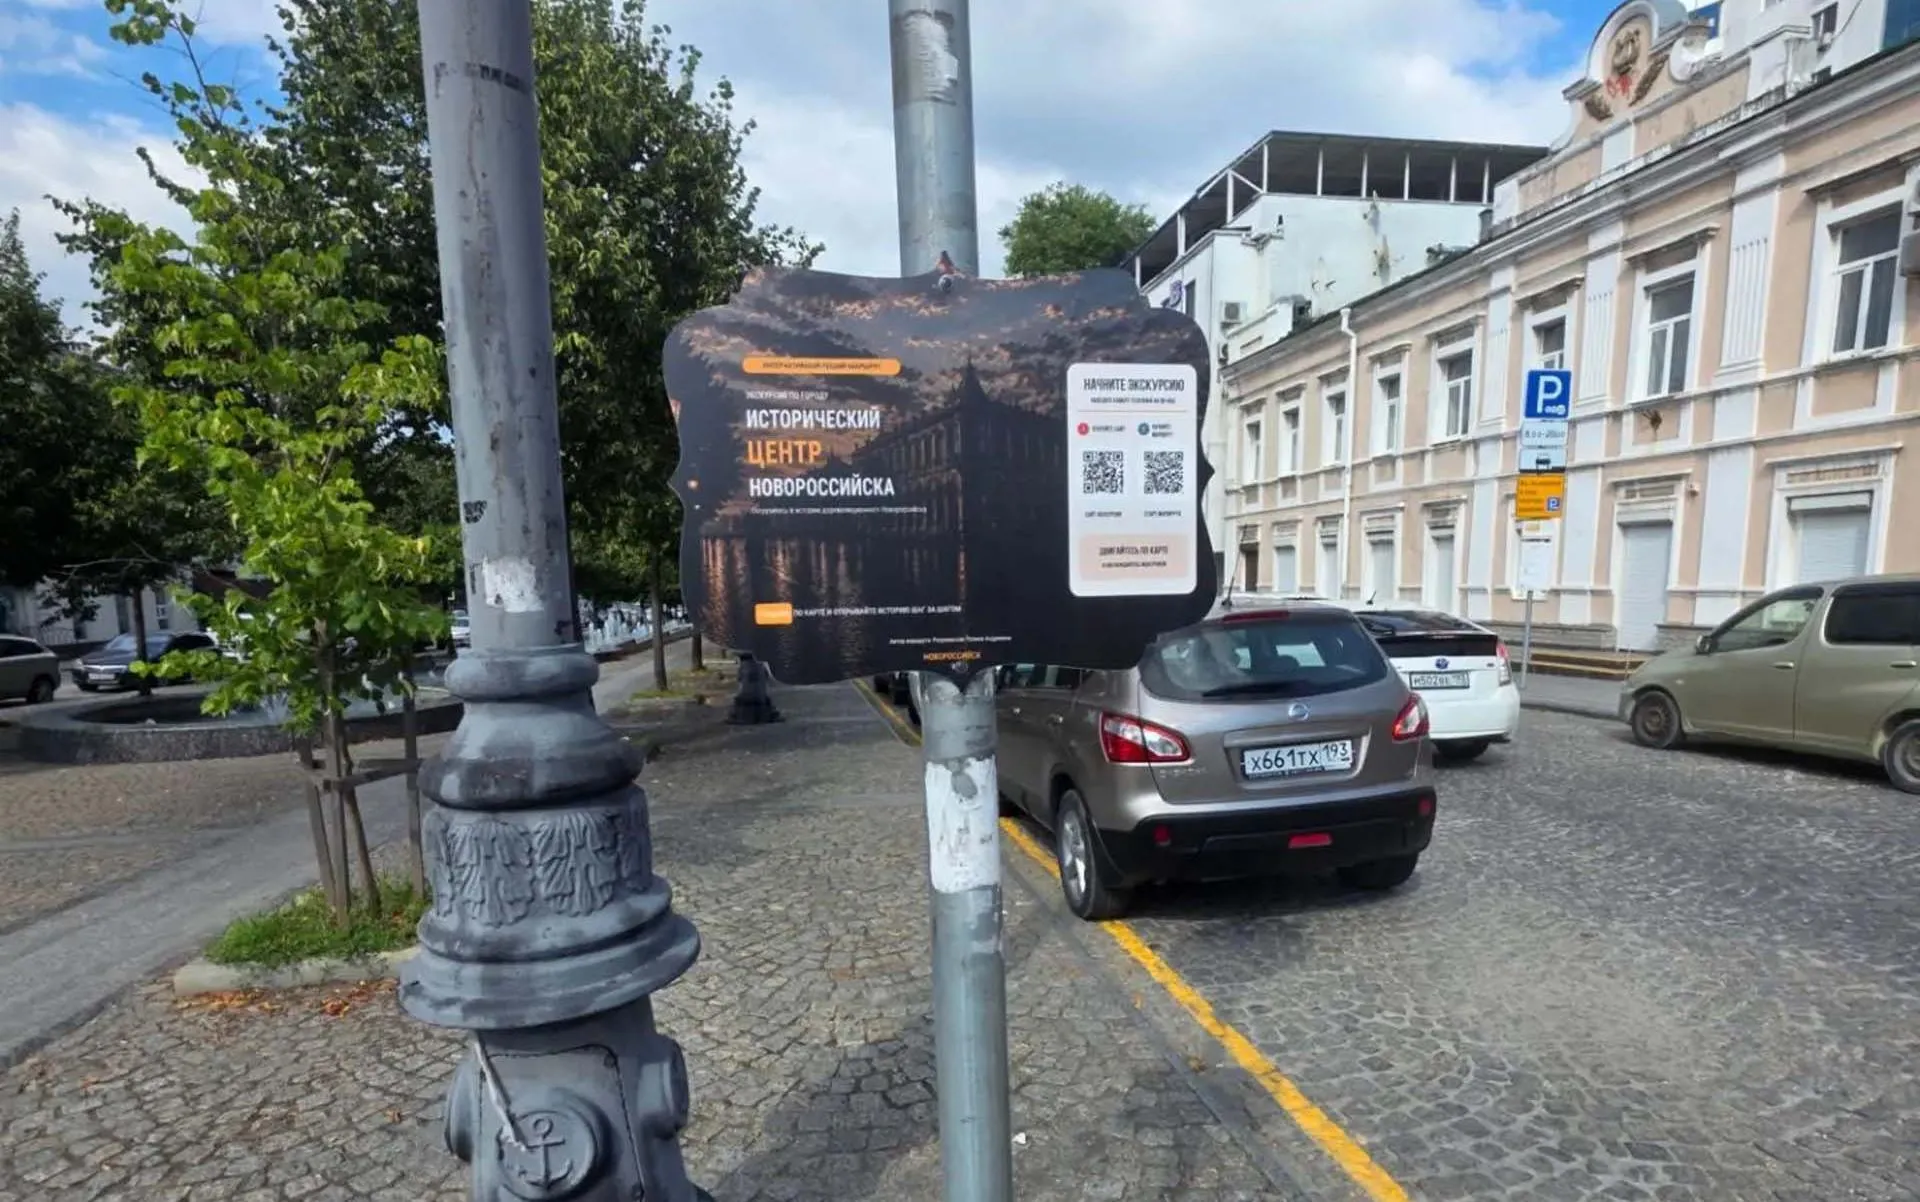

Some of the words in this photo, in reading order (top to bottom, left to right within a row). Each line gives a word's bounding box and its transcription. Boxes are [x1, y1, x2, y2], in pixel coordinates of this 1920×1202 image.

[1083, 378, 1126, 392] НАЧНИТЕ
[1128, 378, 1185, 392] ЭКСКУРСИЮ
[746, 406, 881, 429] ИСТОРИЧЕСКИЙ
[748, 440, 821, 468] ЦЕНТР
[750, 474, 895, 498] НОВОРОССИЙСКА
[1323, 742, 1348, 759] 193
